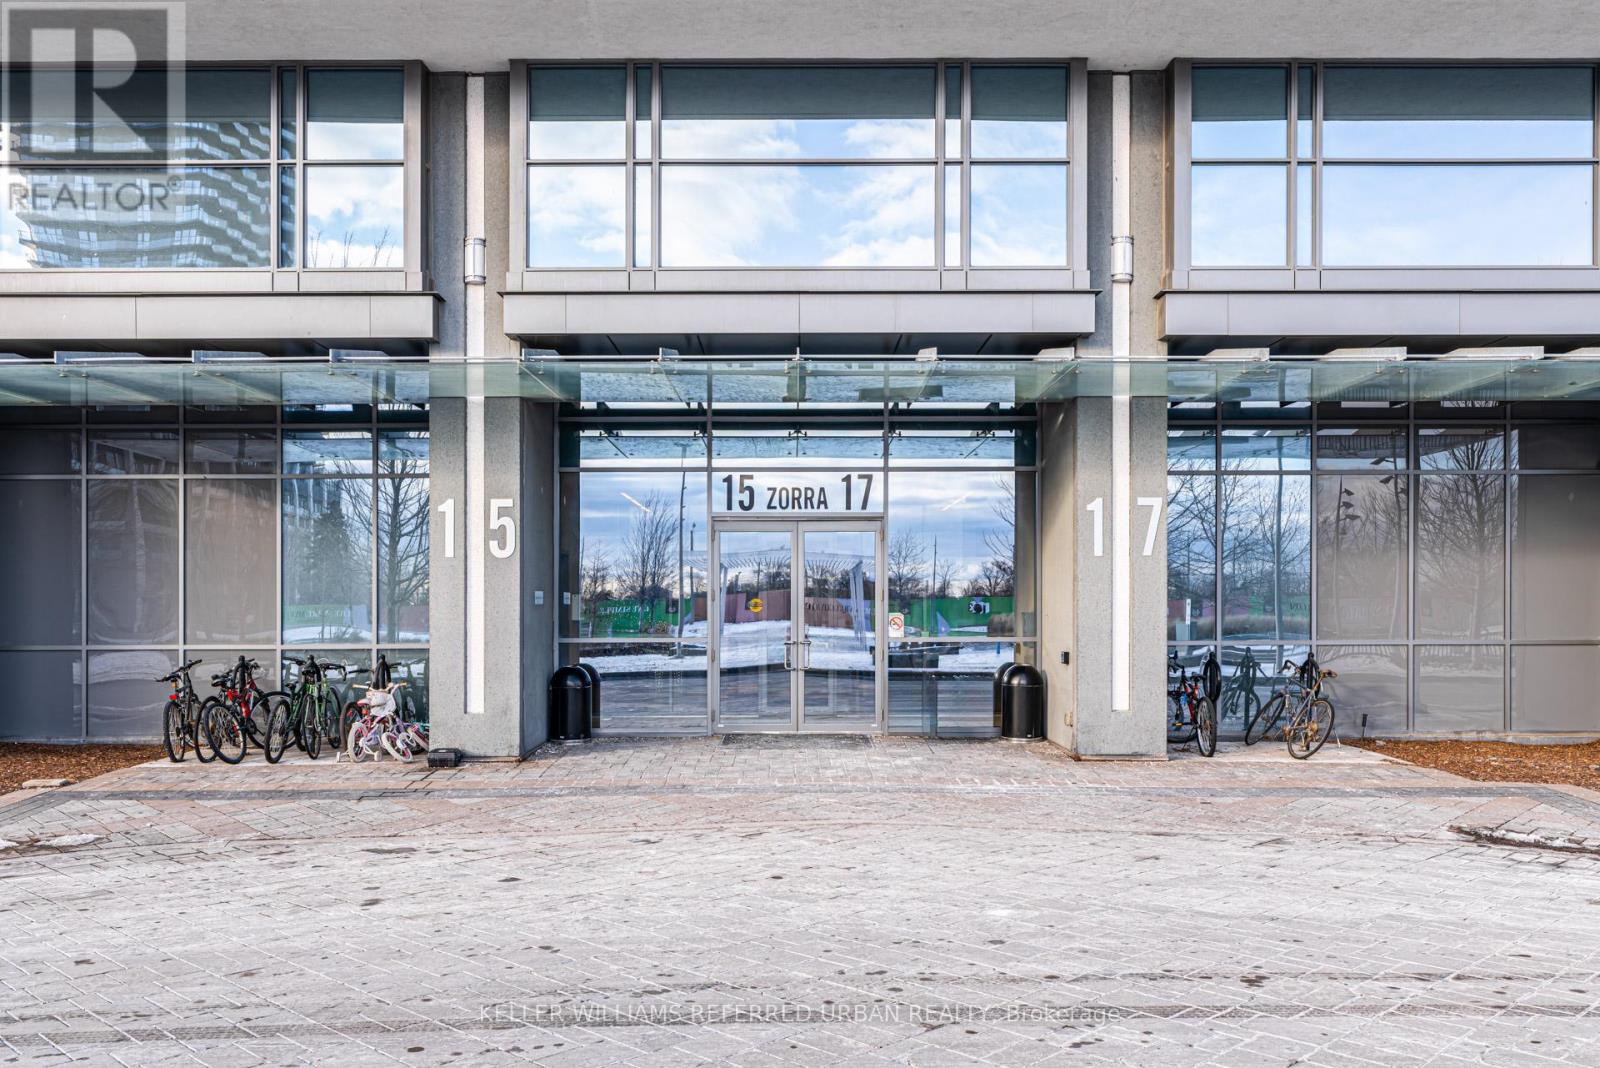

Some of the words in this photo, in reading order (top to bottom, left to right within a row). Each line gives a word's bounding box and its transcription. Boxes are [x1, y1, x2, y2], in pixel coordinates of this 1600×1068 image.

[722, 474, 755, 511] 15
[766, 487, 829, 510] ZORRA
[841, 474, 873, 511] 17
